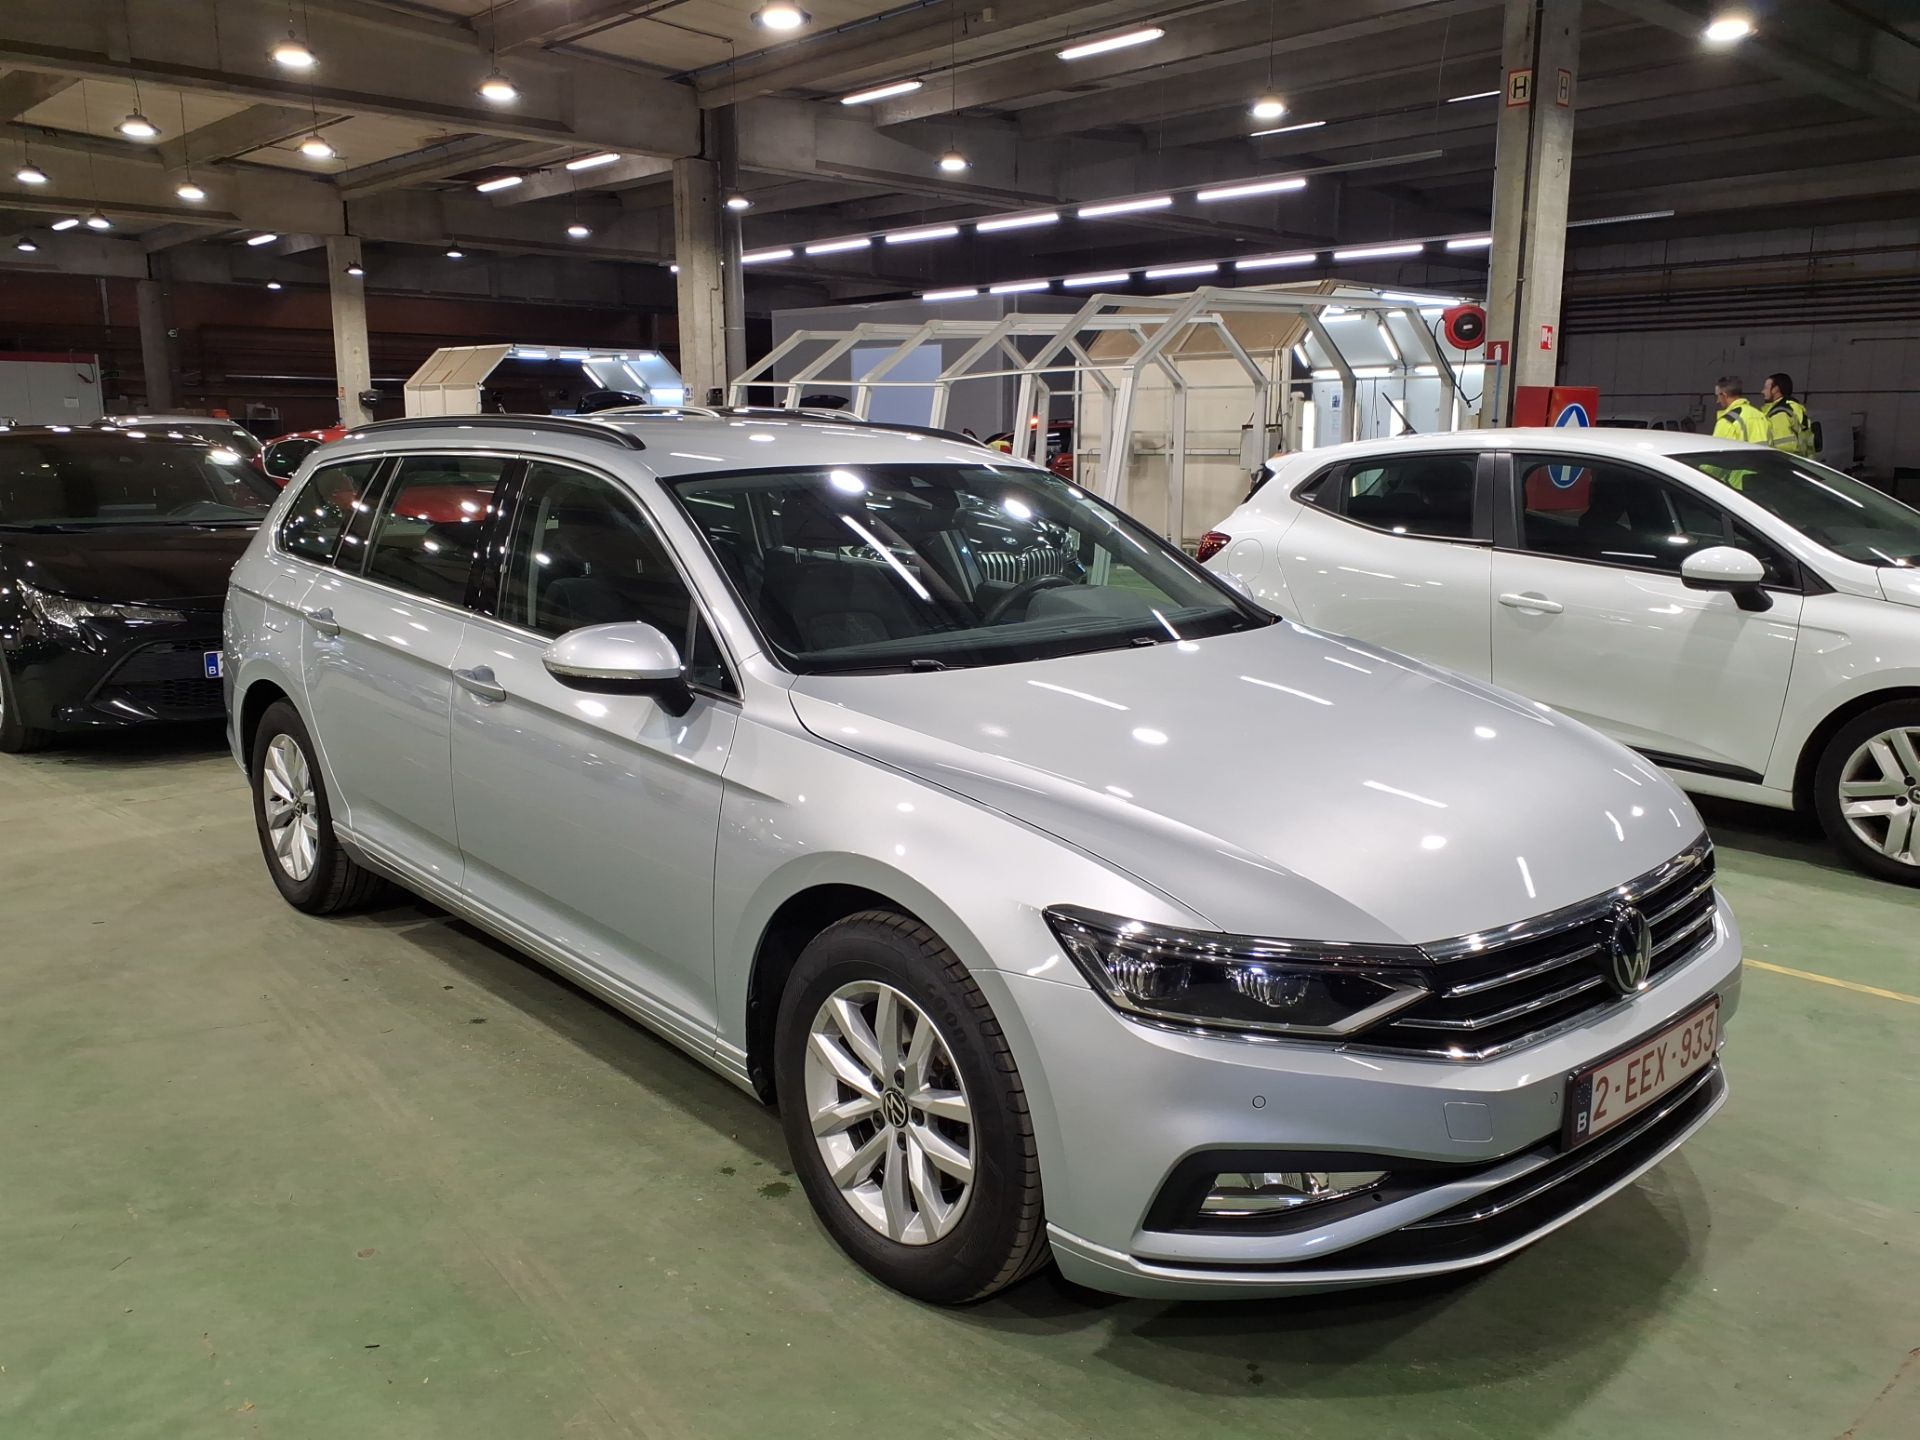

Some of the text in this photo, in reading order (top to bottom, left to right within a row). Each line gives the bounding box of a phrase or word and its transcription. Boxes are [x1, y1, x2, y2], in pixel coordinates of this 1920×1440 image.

[1513, 76, 1527, 99] H
[208, 666, 217, 675] B
[1592, 1011, 1715, 1122] 2-EEX-933
[1577, 1111, 1588, 1133] B
